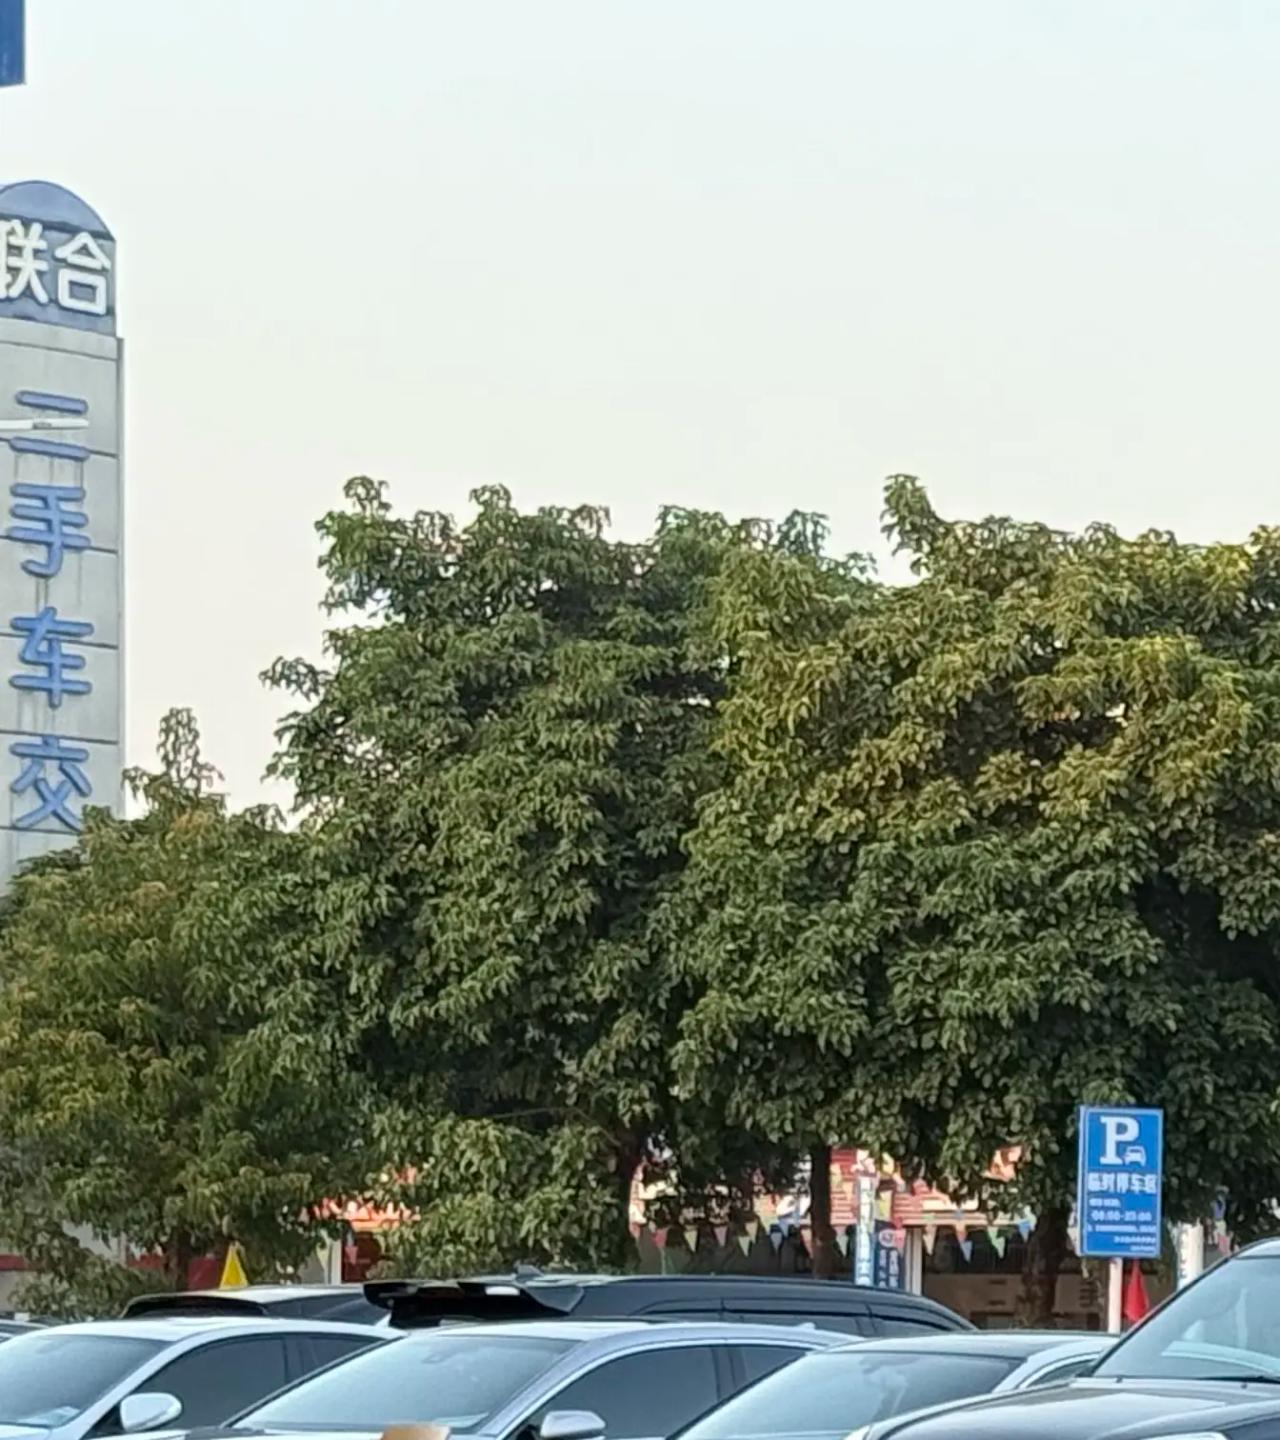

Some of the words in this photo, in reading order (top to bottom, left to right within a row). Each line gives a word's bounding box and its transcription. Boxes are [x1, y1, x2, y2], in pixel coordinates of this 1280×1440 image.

[0, 219, 111, 316] 联合
[7, 390, 94, 830] 二手车交
[1099, 1116, 1140, 1165] P
